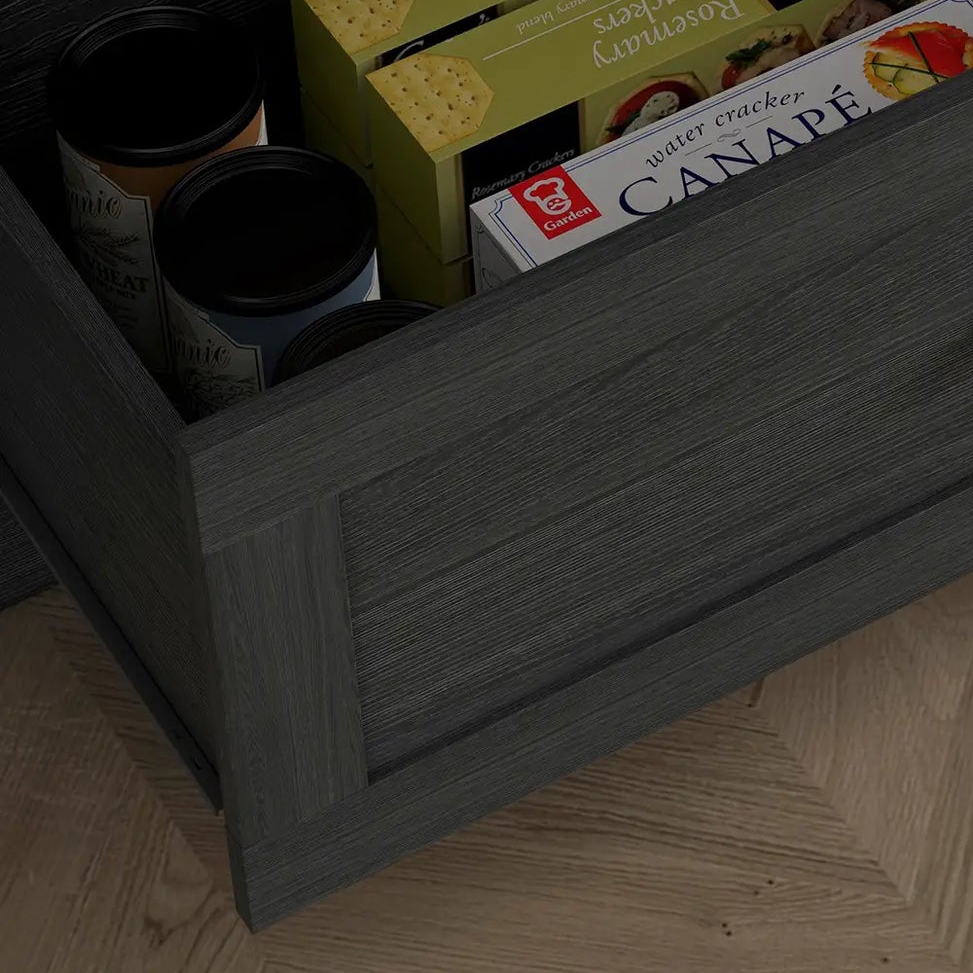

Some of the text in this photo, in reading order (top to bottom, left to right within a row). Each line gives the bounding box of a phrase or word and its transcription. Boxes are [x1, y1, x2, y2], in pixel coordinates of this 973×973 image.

[516, 11, 555, 35] blend
[618, 84, 873, 217] CANAPÉ
[645, 91, 805, 168] water cracker
[543, 206, 594, 232] Garden
